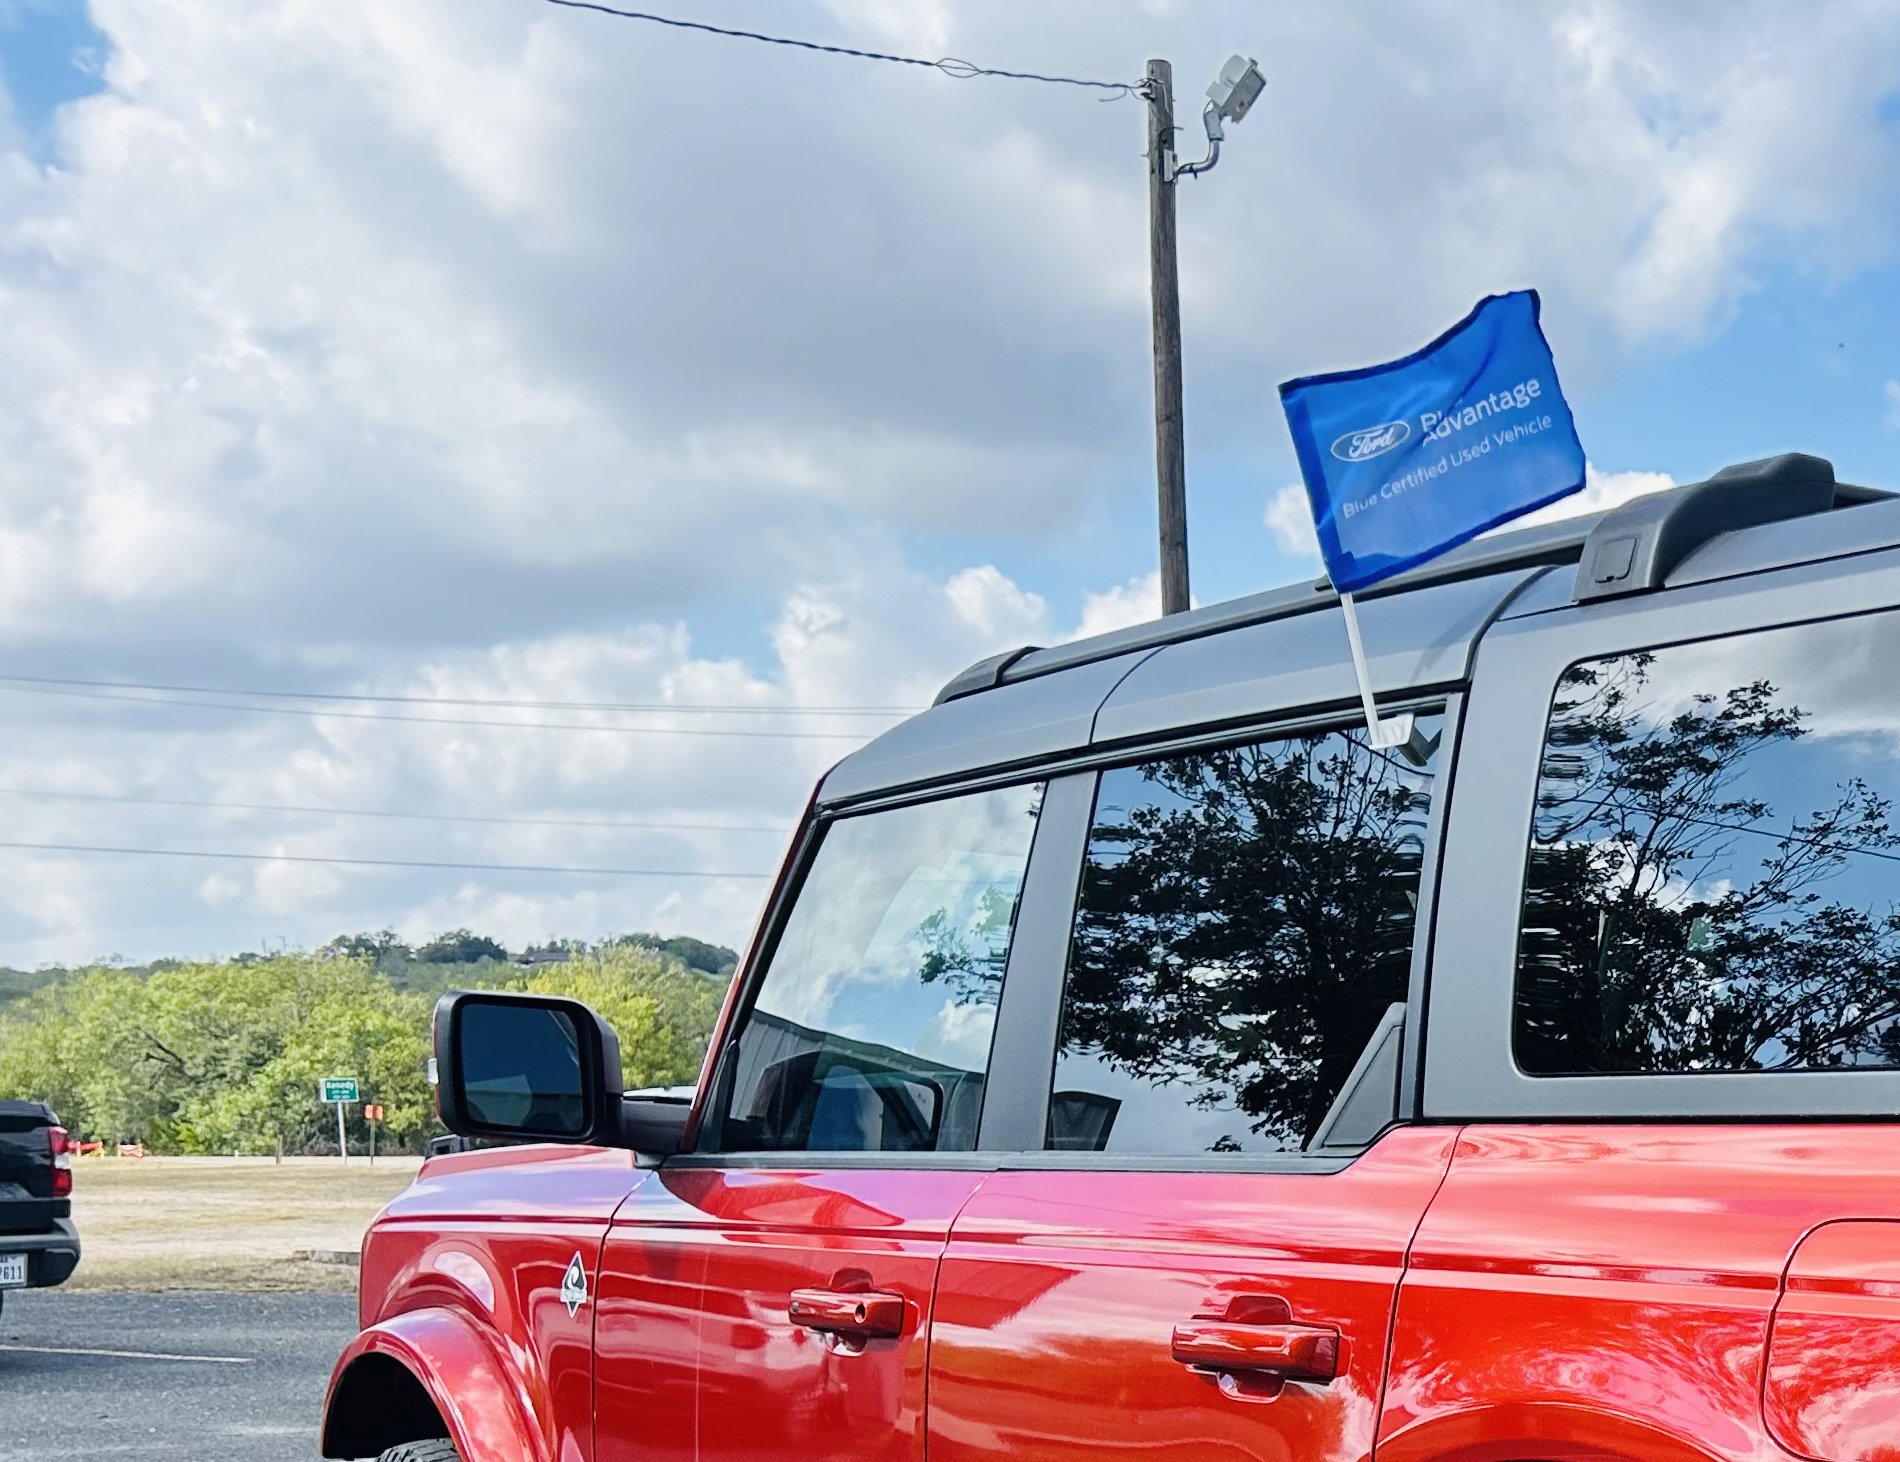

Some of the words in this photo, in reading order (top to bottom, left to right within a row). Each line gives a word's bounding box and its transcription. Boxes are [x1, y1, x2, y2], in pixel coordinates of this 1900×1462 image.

[1343, 494, 1378, 518] Blue
[1381, 459, 1448, 499] Certified
[1450, 436, 1490, 467] Used
[1493, 414, 1553, 447] Vehicle
[1349, 427, 1394, 458] Ford
